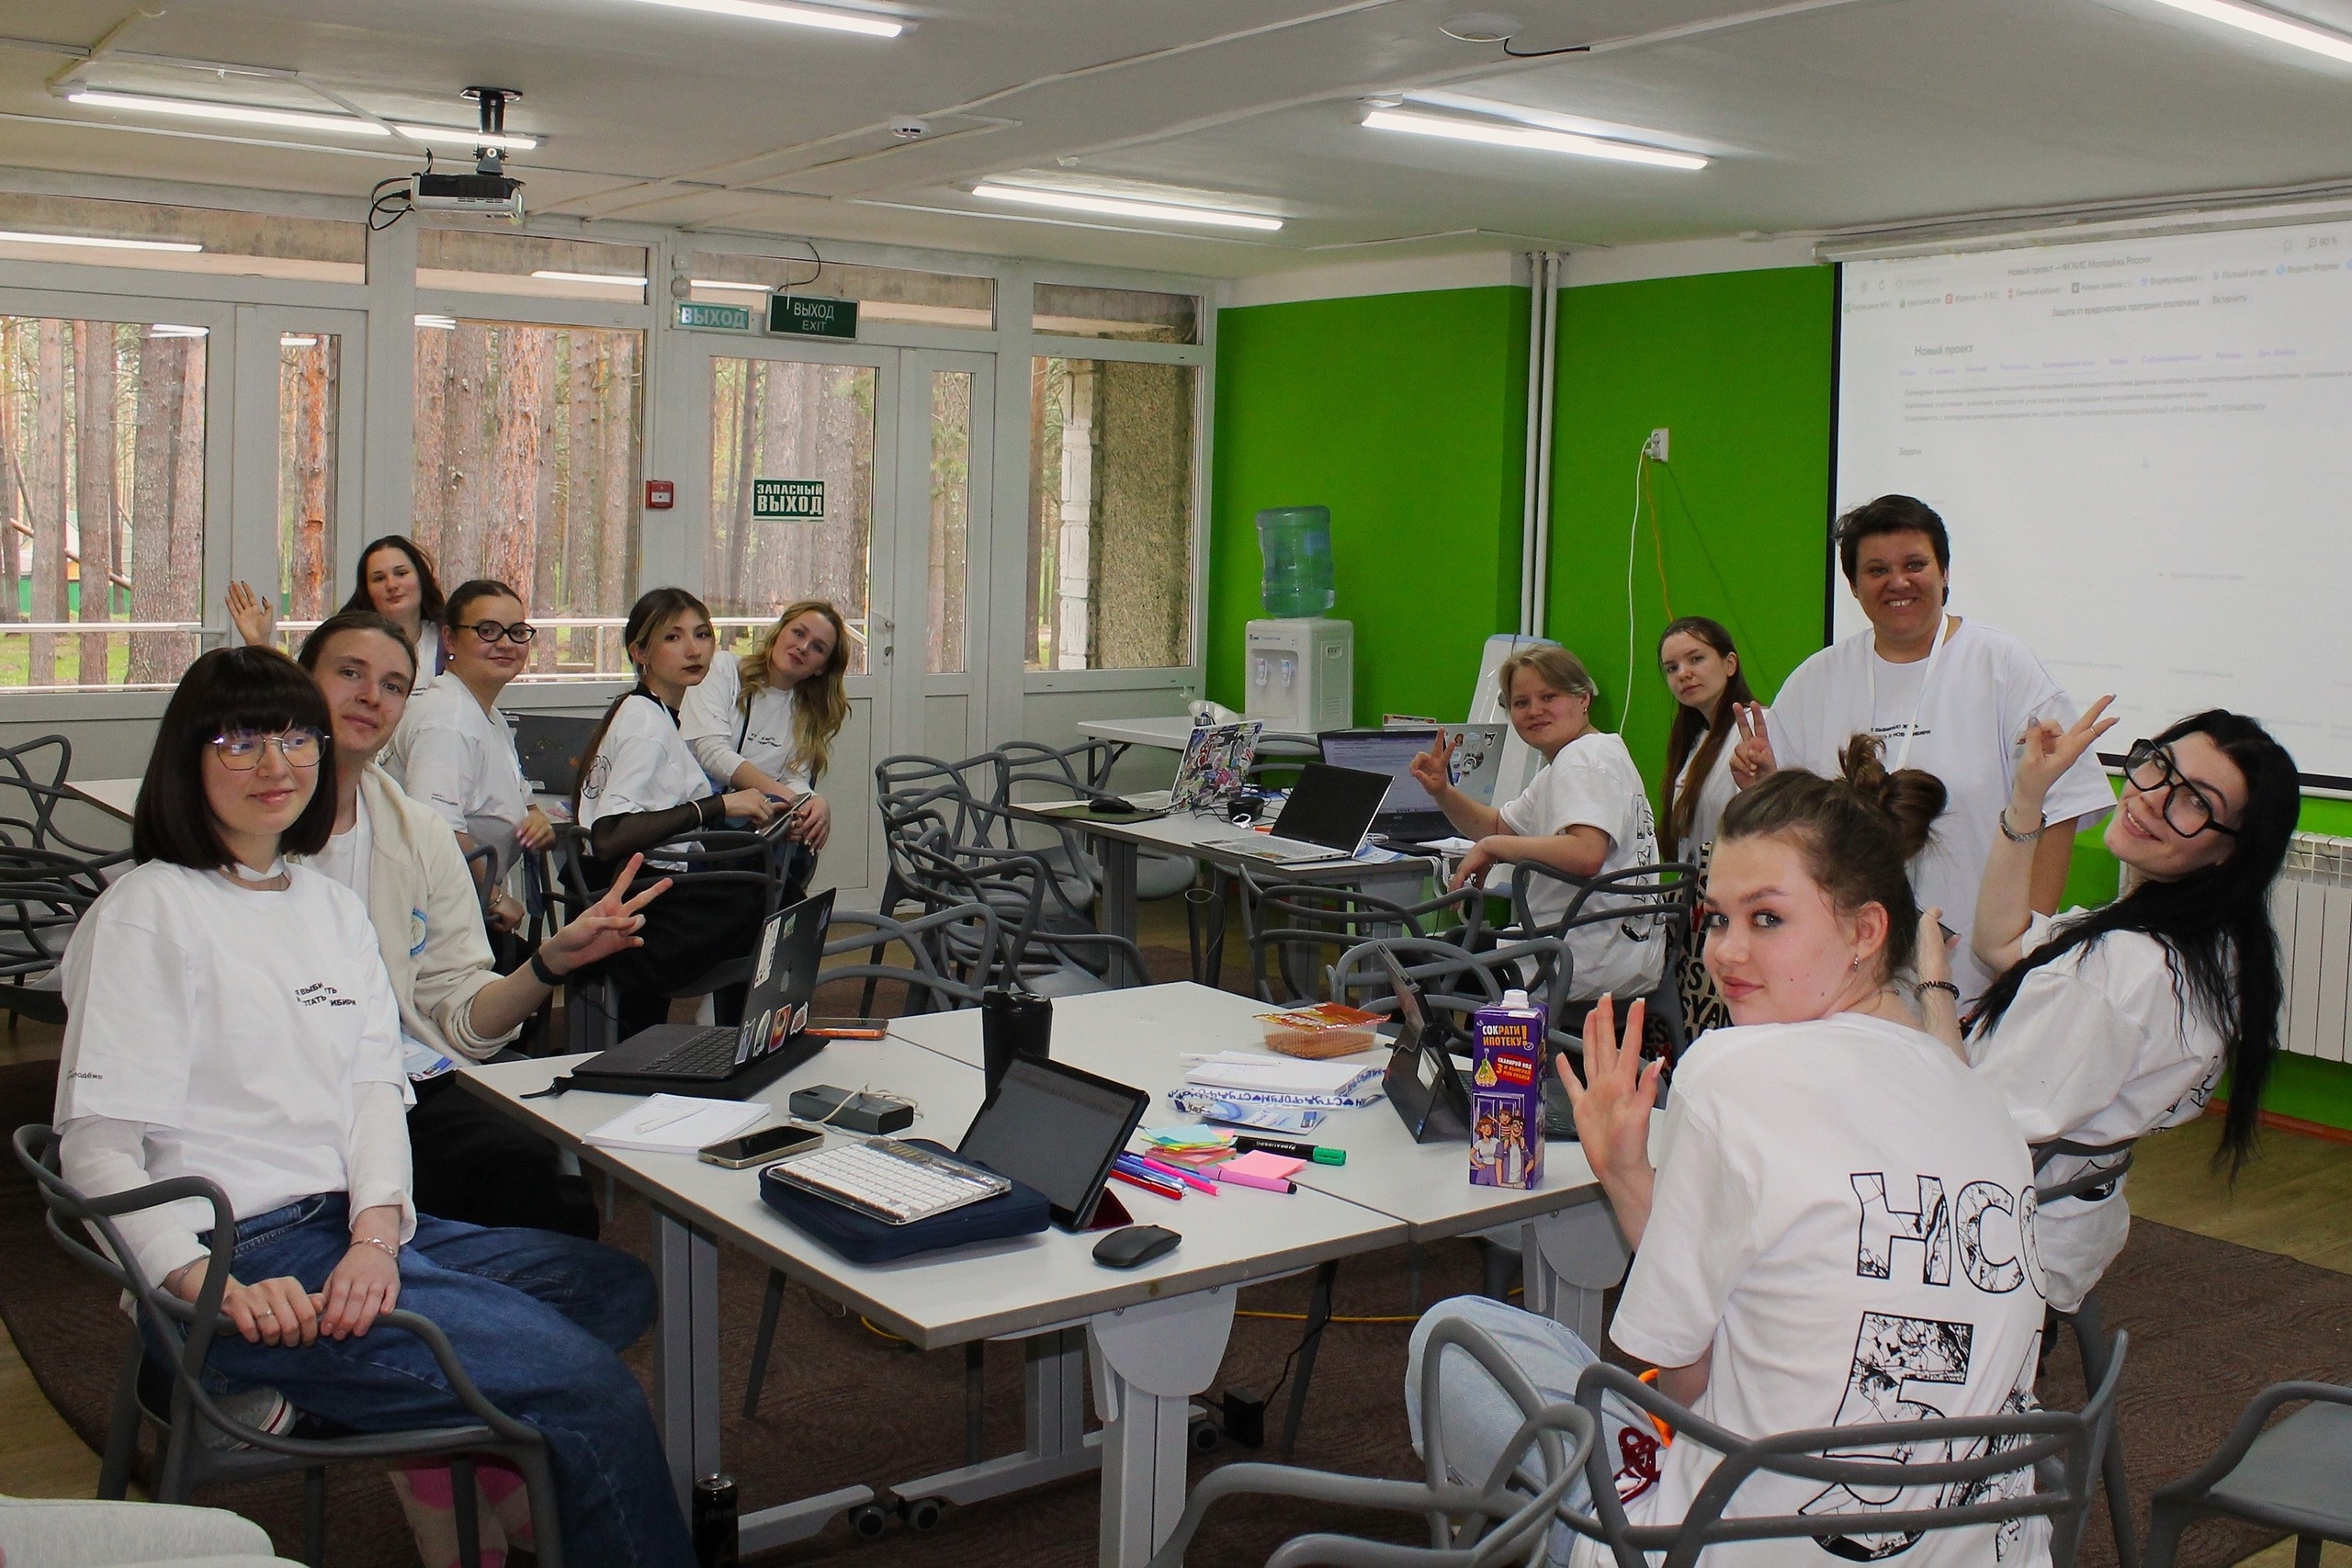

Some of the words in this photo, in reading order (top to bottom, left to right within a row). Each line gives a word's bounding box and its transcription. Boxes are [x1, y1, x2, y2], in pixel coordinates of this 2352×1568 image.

[2007, 266, 2030, 276] Новый
[2031, 265, 2053, 276] проект
[794, 302, 834, 321] ВЫХОД
[681, 308, 746, 329] ВЫХОД
[802, 321, 826, 332] EXIT
[1915, 344, 1944, 356] Новый
[1945, 344, 1974, 356] проект
[756, 482, 823, 495] ЗАПАСНЫЙ
[757, 495, 823, 515] ВЫХОД
[1482, 1024, 1521, 1036] СОКРАТИ
[1498, 1056, 1521, 1068] СКАНИРУЙ
[1496, 1064, 1502, 1075] 3
